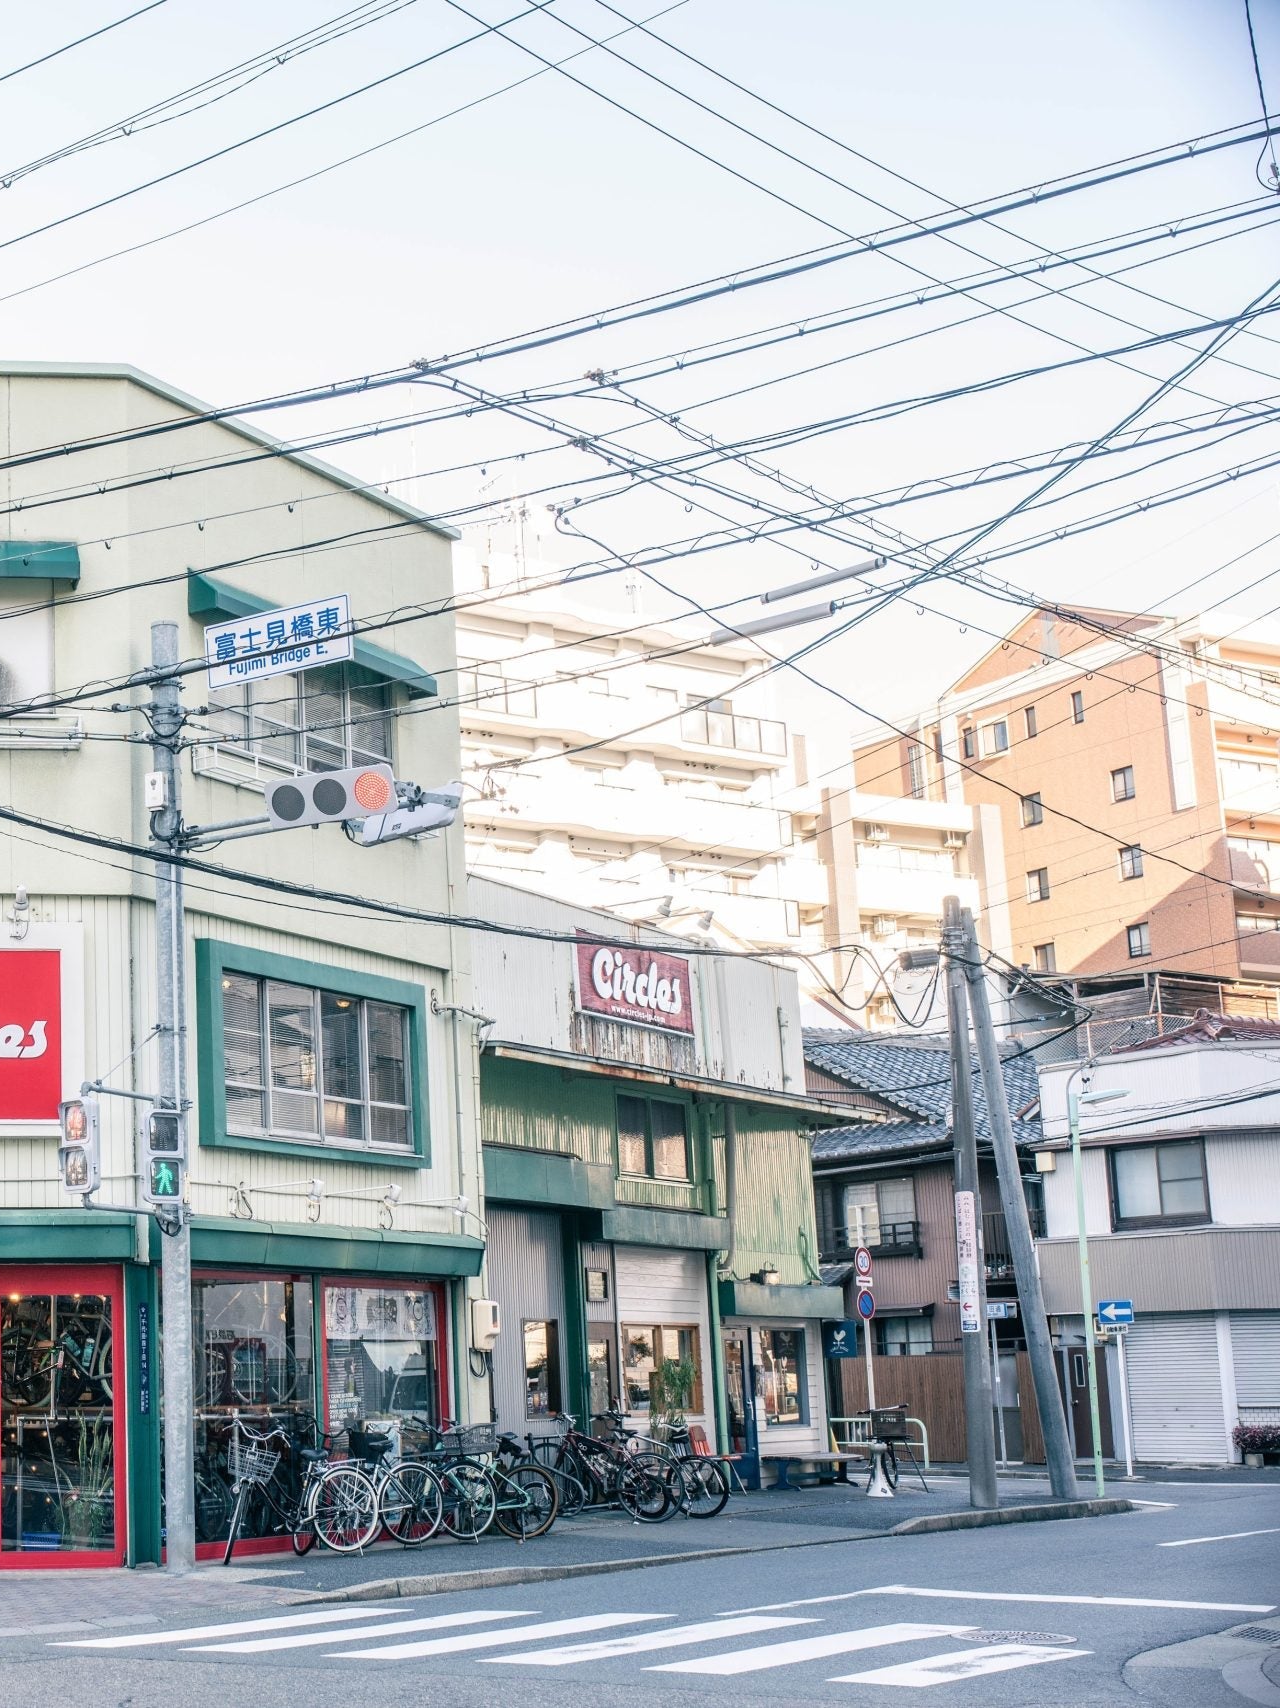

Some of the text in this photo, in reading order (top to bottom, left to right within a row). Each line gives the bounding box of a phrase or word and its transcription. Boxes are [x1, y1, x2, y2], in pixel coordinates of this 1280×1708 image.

[215, 607, 341, 661] 富士見橋東
[229, 643, 328, 675] Fujimi Bridge E.
[593, 948, 682, 1015] Circles
[859, 1256, 869, 1268] 30
